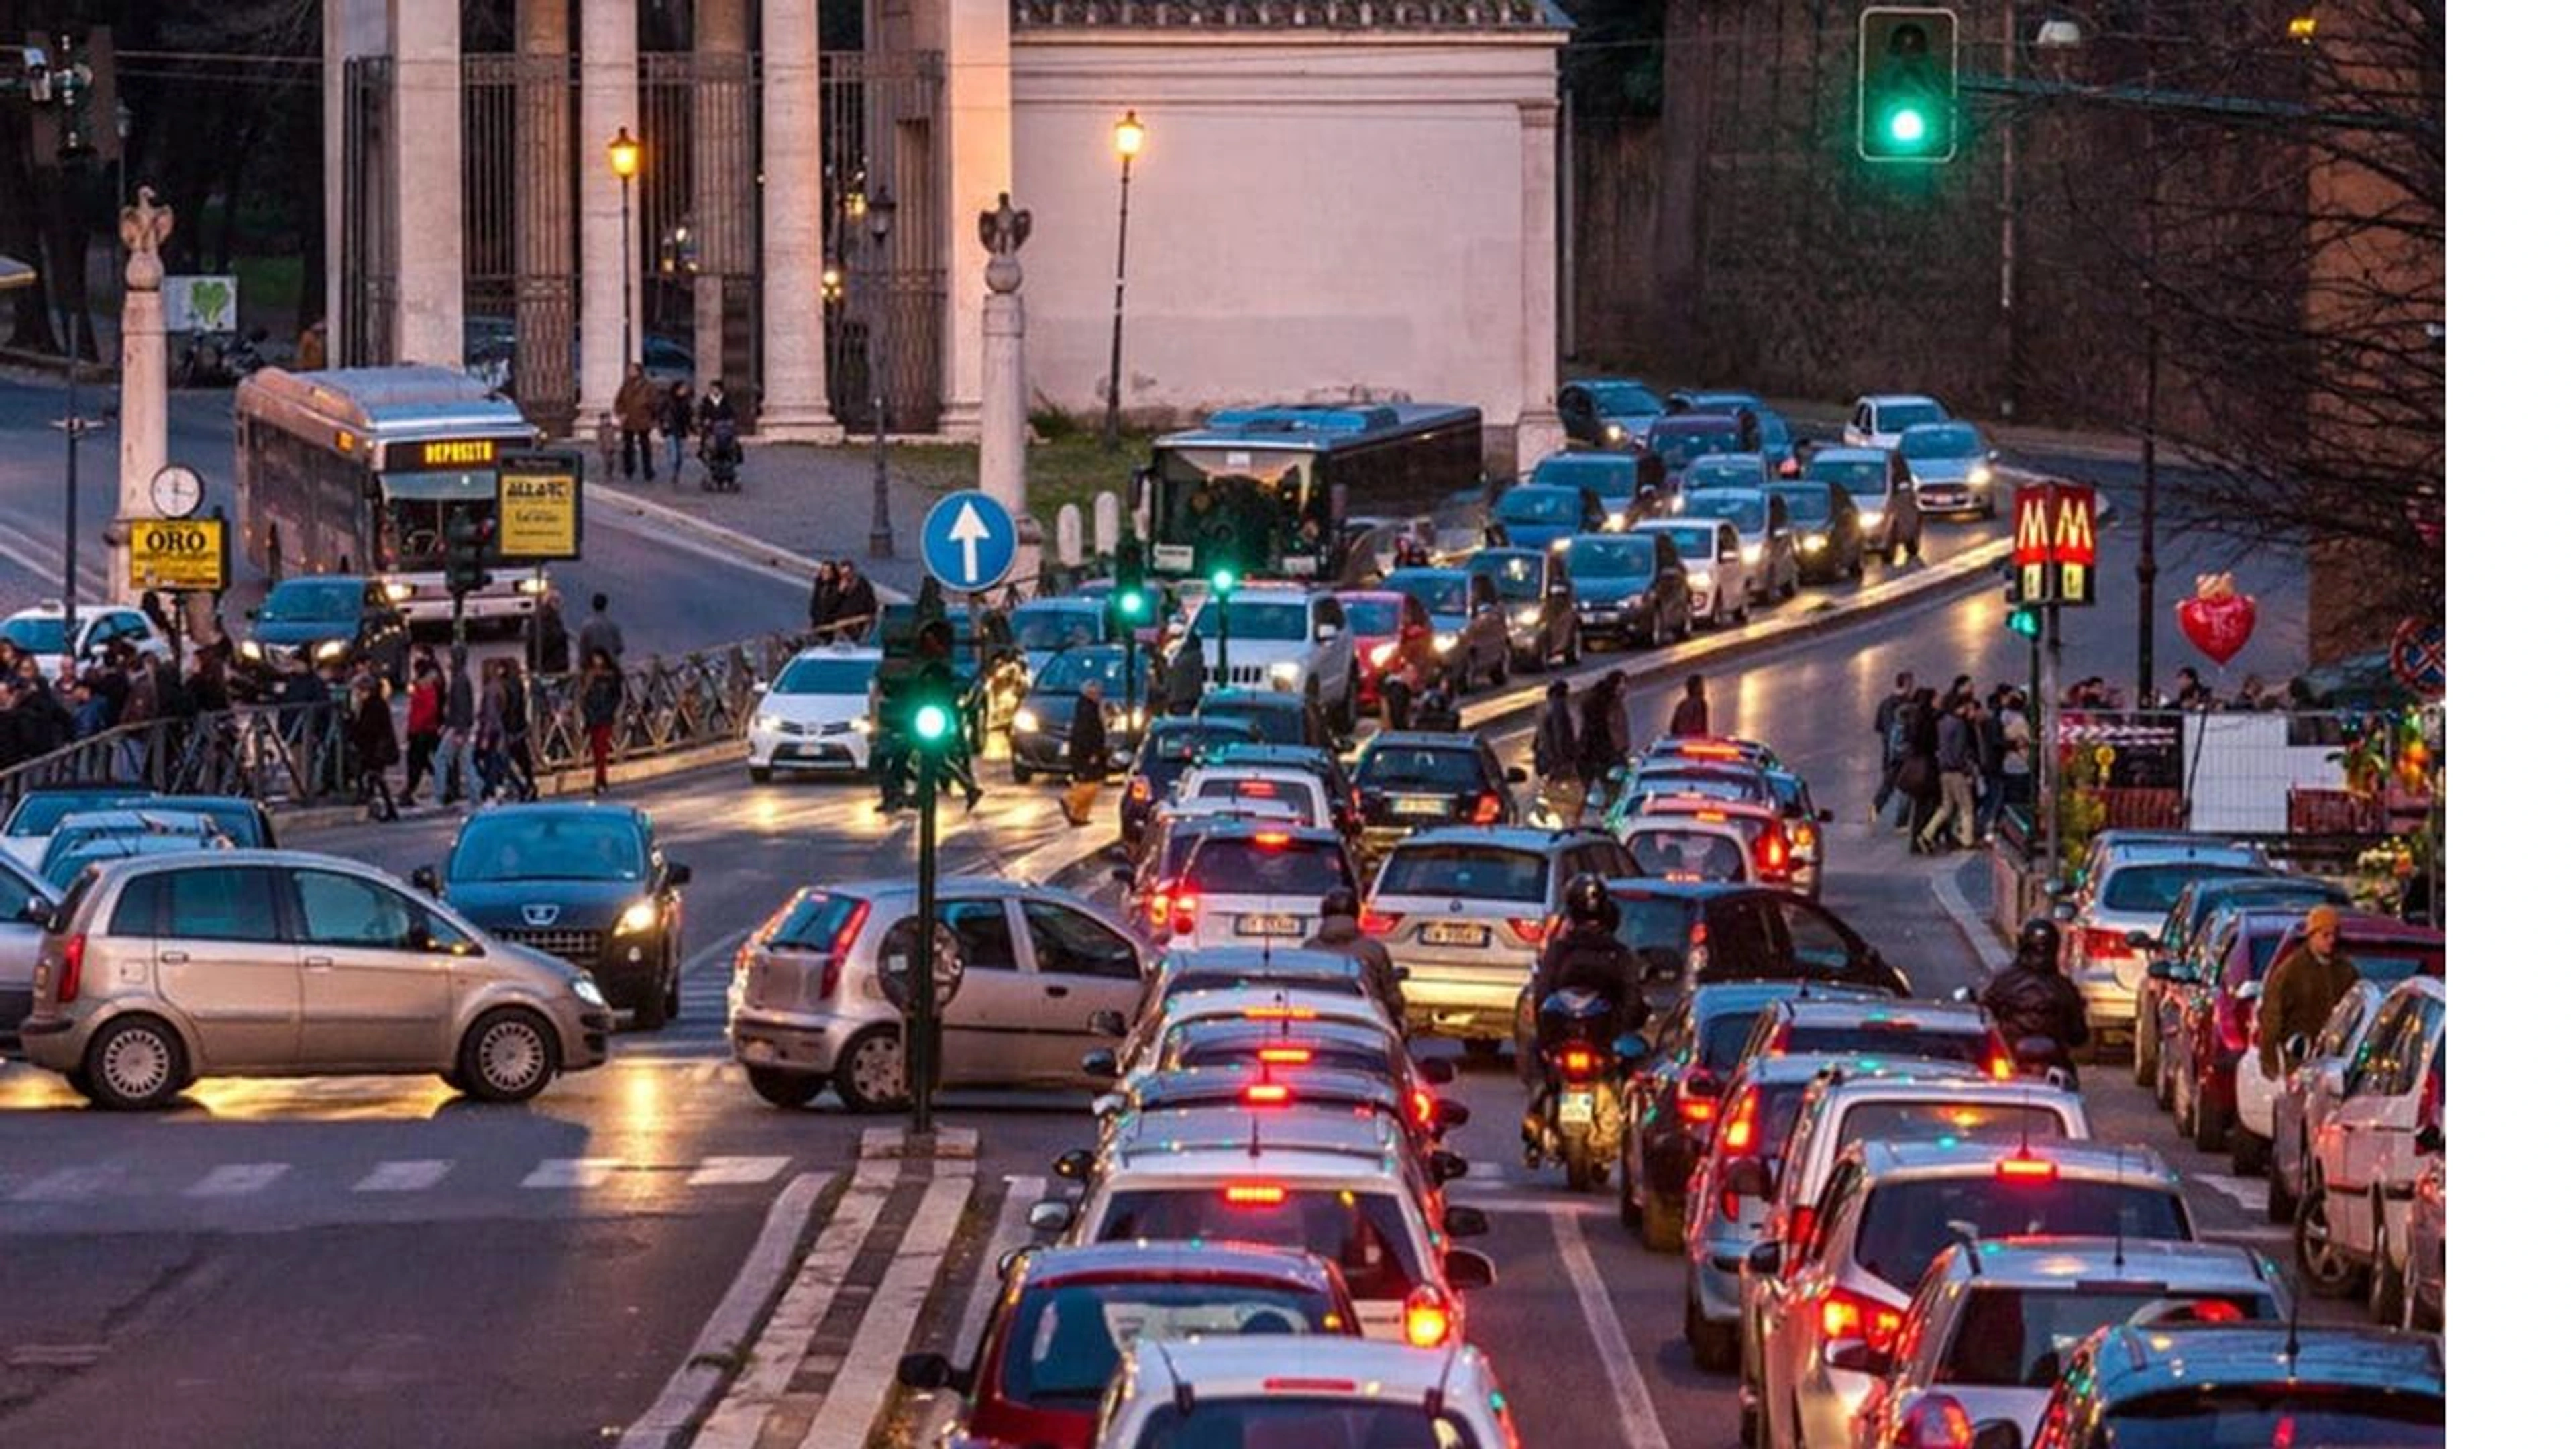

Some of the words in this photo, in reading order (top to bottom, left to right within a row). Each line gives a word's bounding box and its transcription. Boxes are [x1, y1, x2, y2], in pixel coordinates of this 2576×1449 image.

[425, 441, 493, 464] DEPOSITO
[146, 531, 206, 551] ORO
[2017, 498, 2049, 550] M
[2054, 497, 2092, 550] M
